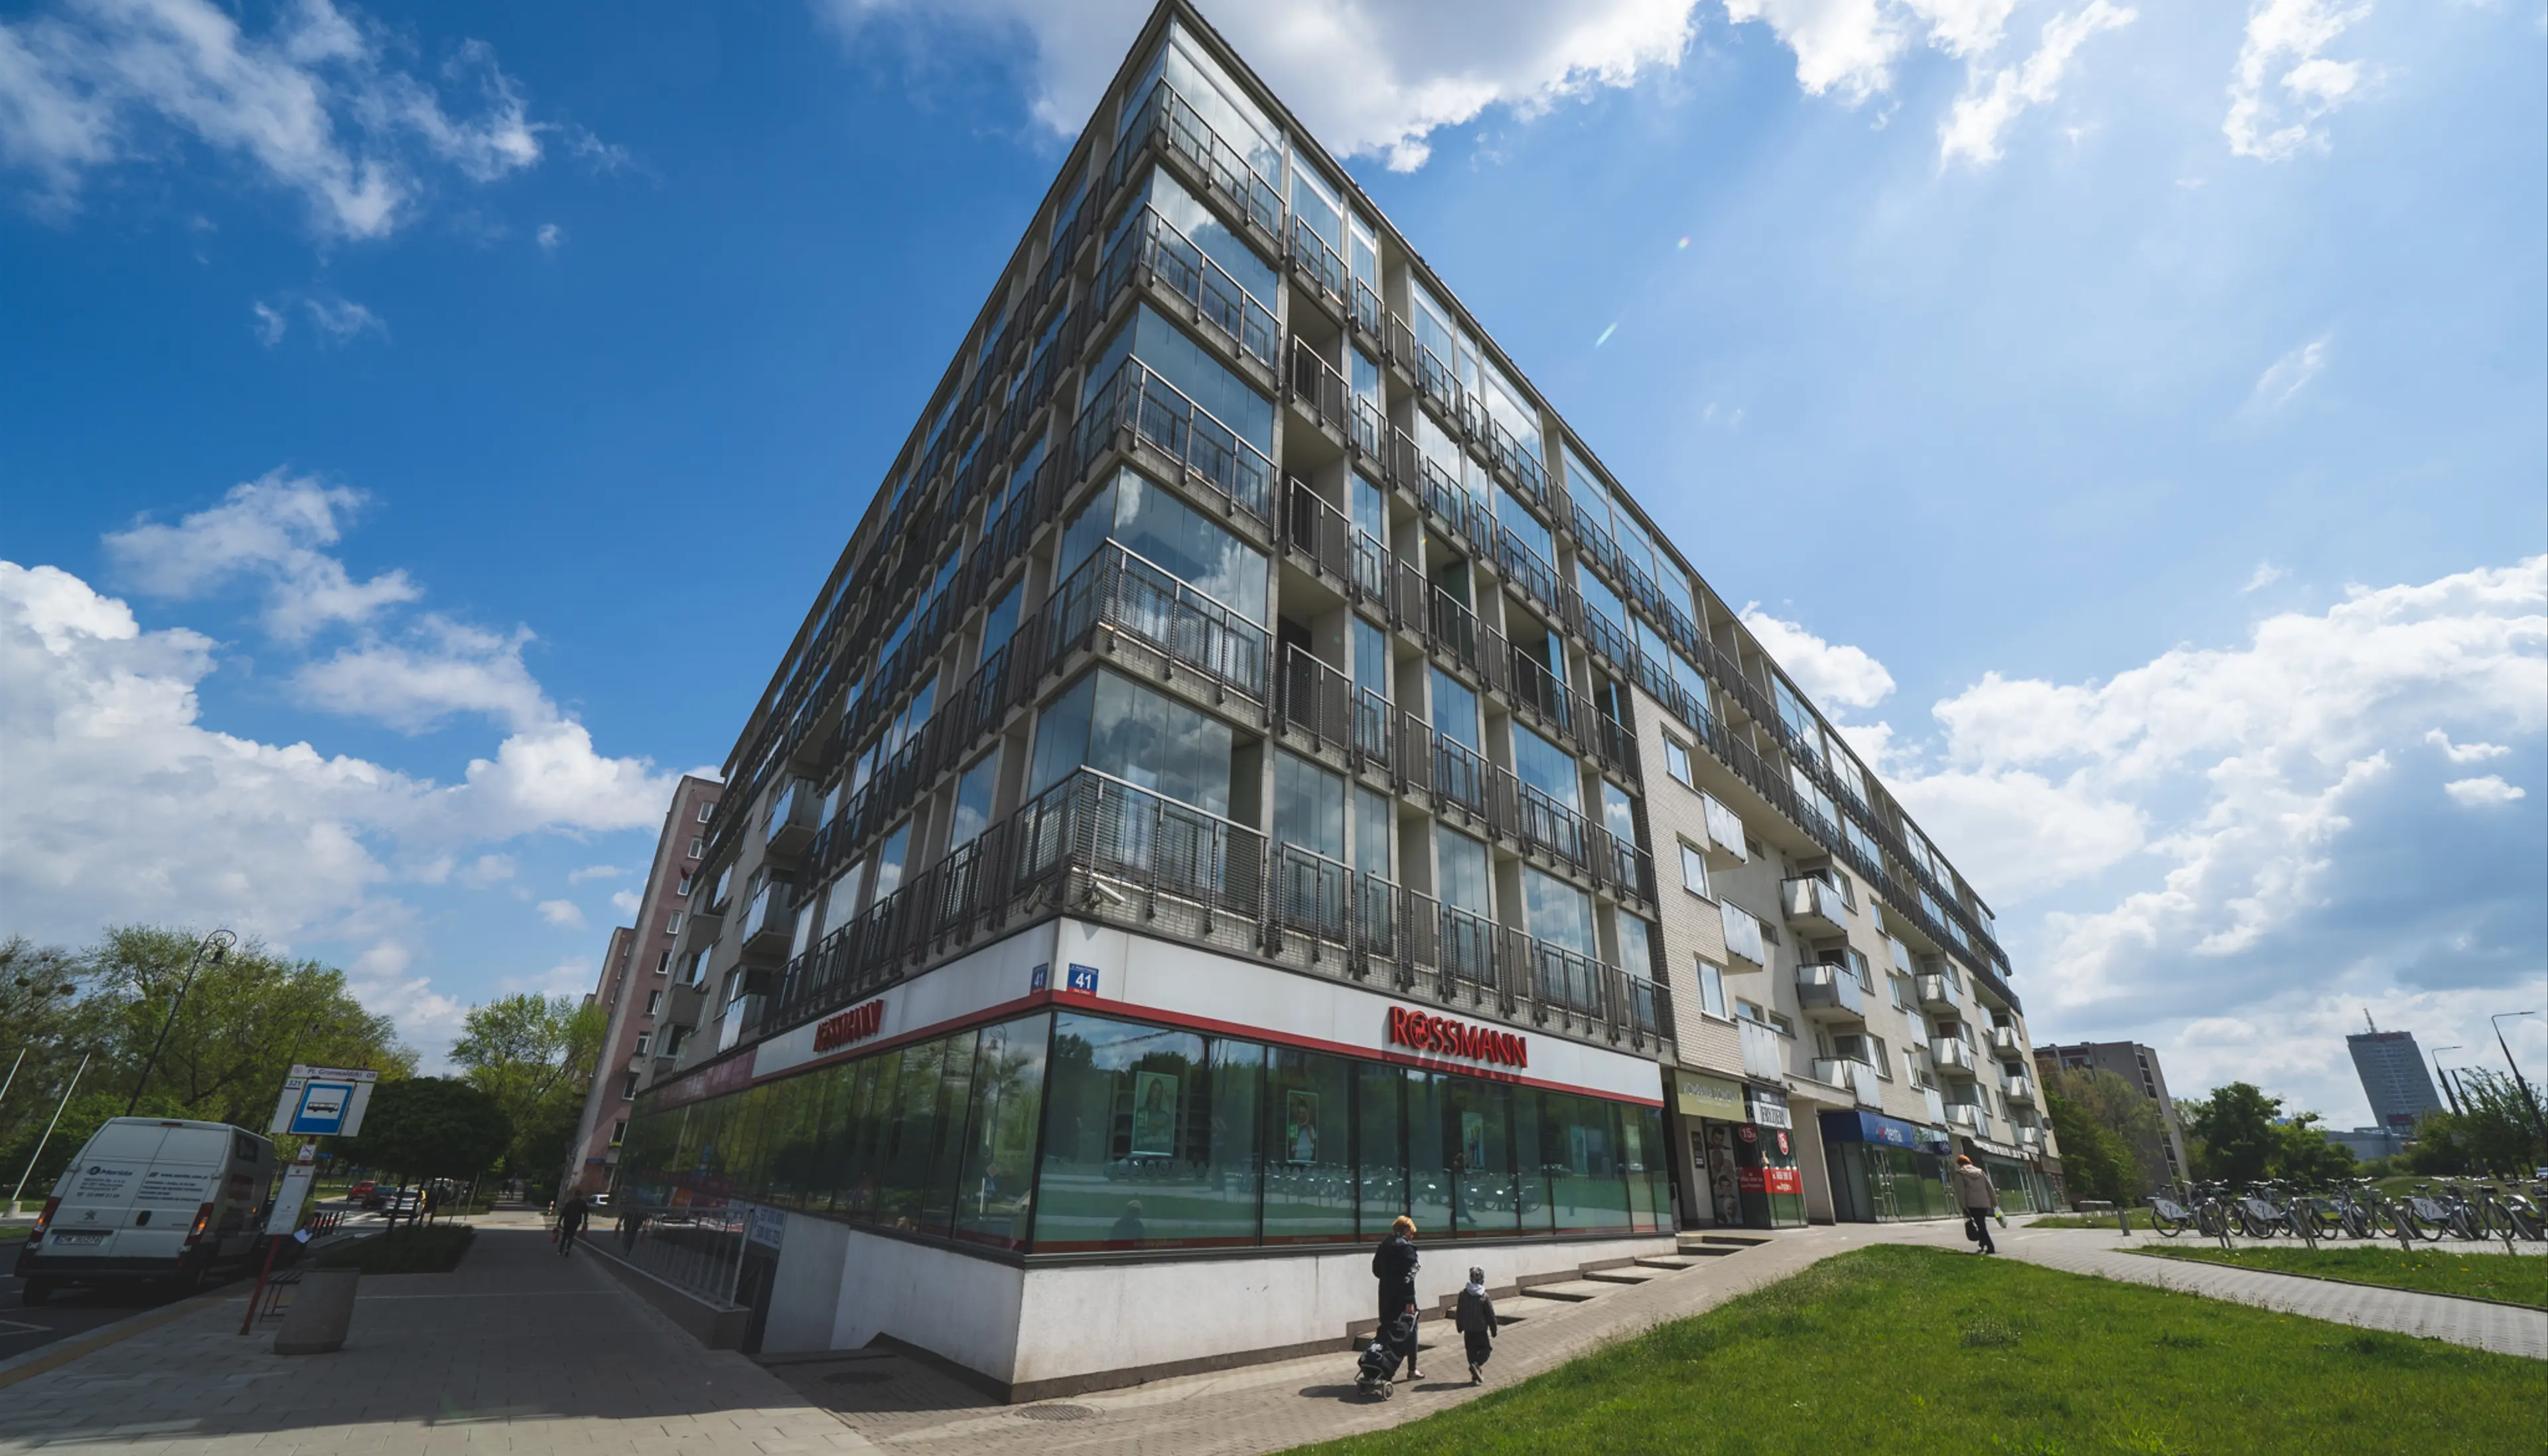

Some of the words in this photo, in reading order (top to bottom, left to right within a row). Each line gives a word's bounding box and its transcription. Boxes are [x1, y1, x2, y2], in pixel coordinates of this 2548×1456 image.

[1034, 971, 1045, 987] 41
[1075, 972, 1092, 990] 41
[1389, 1006, 1528, 1069] ROSSMANN
